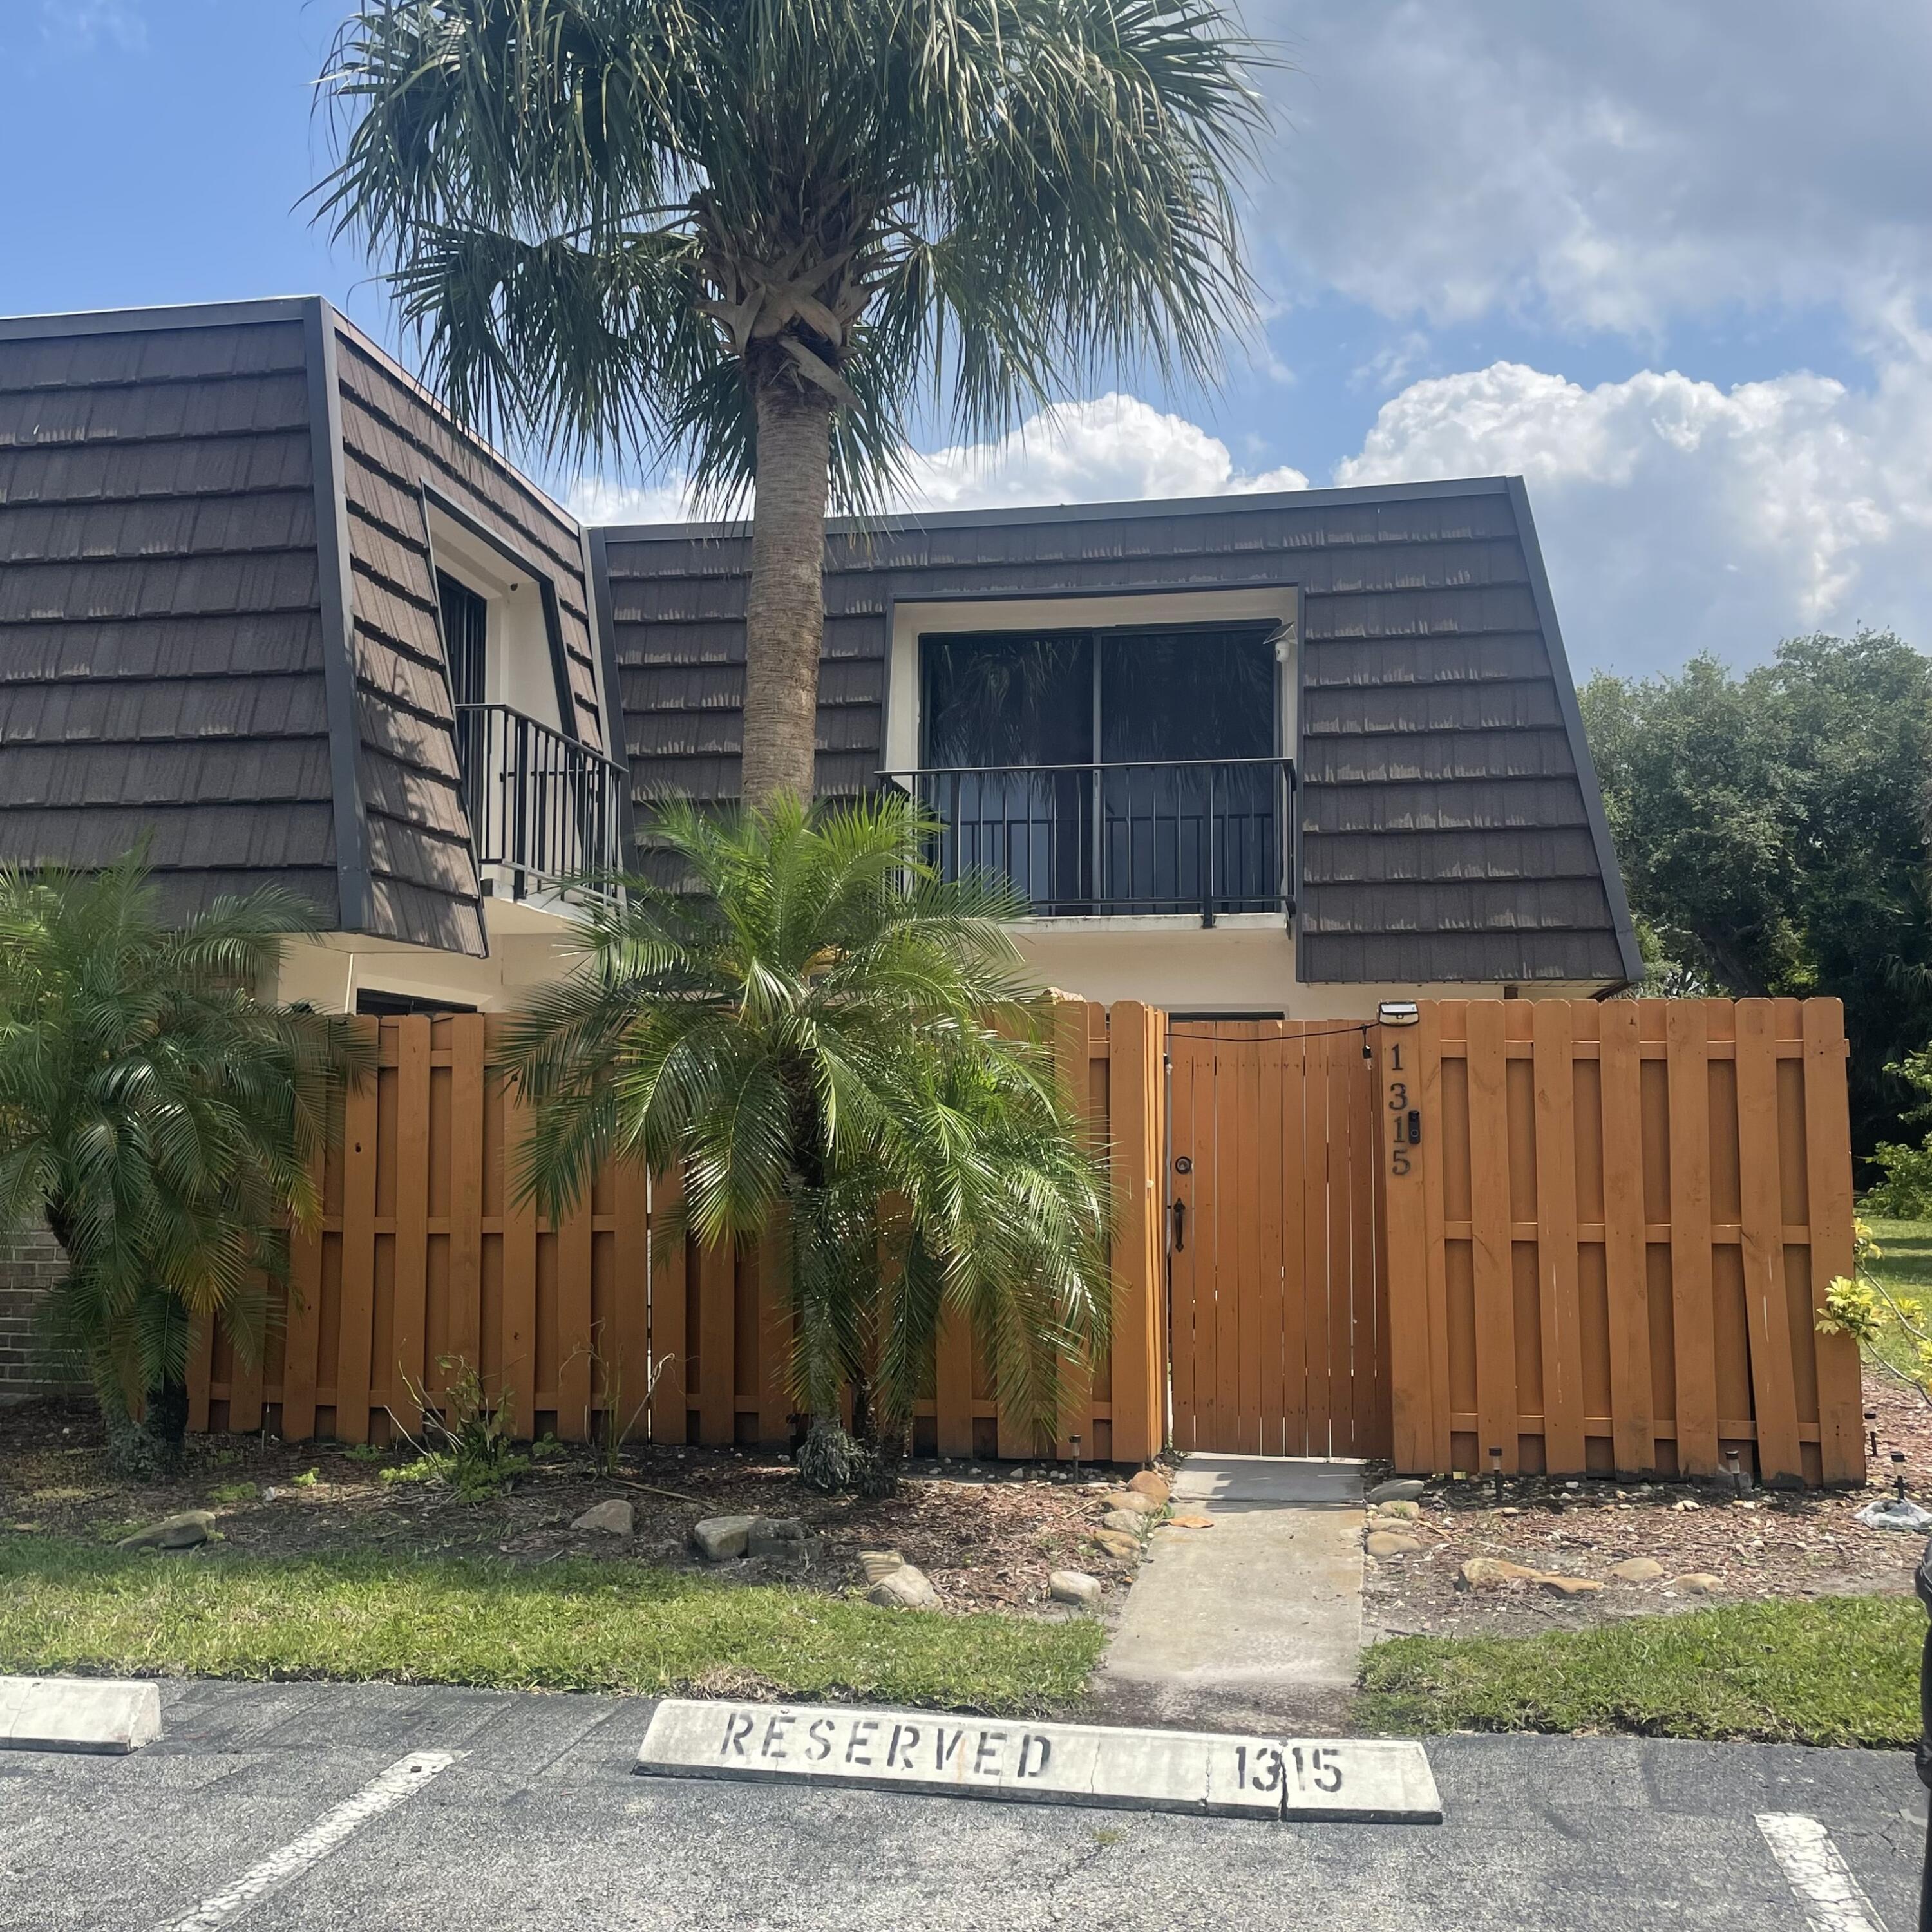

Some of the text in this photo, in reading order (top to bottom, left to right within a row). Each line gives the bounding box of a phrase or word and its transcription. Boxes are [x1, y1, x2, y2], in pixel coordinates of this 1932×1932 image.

[1388, 1043, 1411, 1176] 1315
[721, 1712, 1343, 1792] RESERVED 1315
